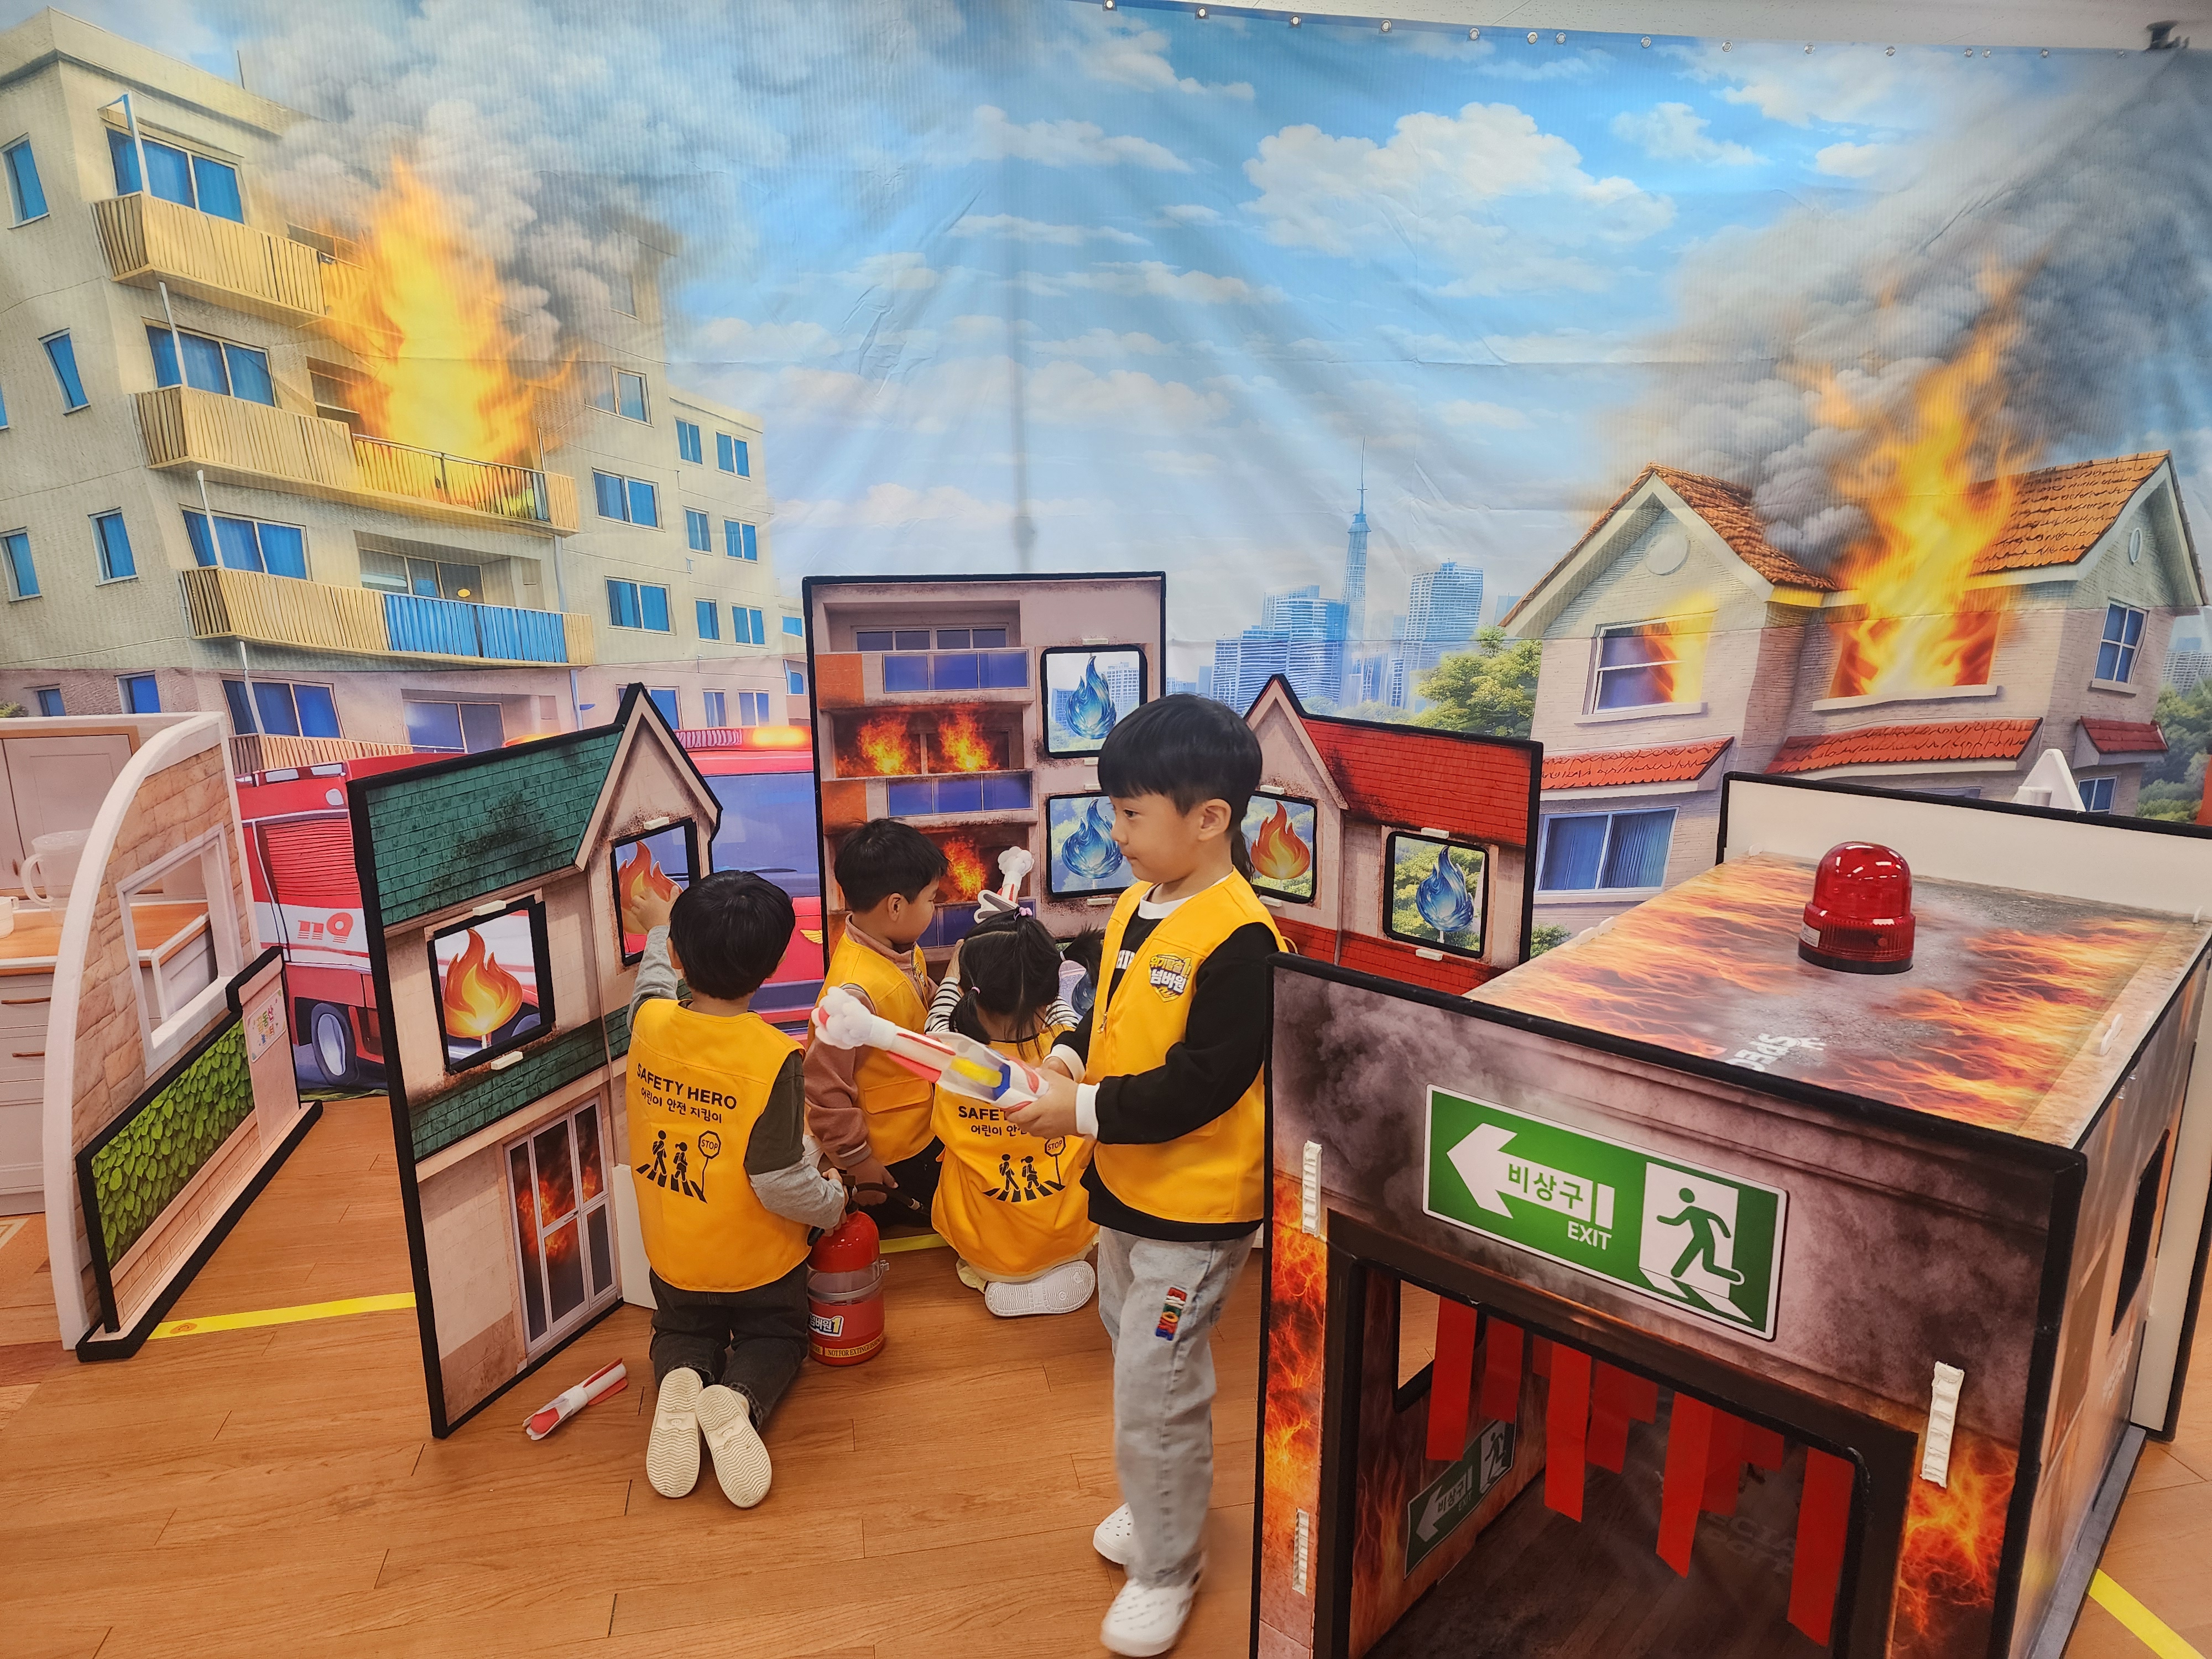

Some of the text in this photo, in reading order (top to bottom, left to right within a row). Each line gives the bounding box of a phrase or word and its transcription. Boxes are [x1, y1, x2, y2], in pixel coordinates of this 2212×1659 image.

[298, 912, 353, 943] 119
[1150, 969, 1187, 993] 넘버원
[637, 1063, 737, 1110] SAFETY HERO
[641, 1087, 722, 1124] 어린이 안전 지킴이
[701, 1139, 718, 1151] STOP
[971, 1125, 1002, 1136] 어린이
[1047, 1140, 1062, 1150] STOP
[1507, 1163, 1584, 1210] 비상구
[1568, 1221, 1612, 1250] EXIT
[1438, 1481, 1464, 1513] 비상구
